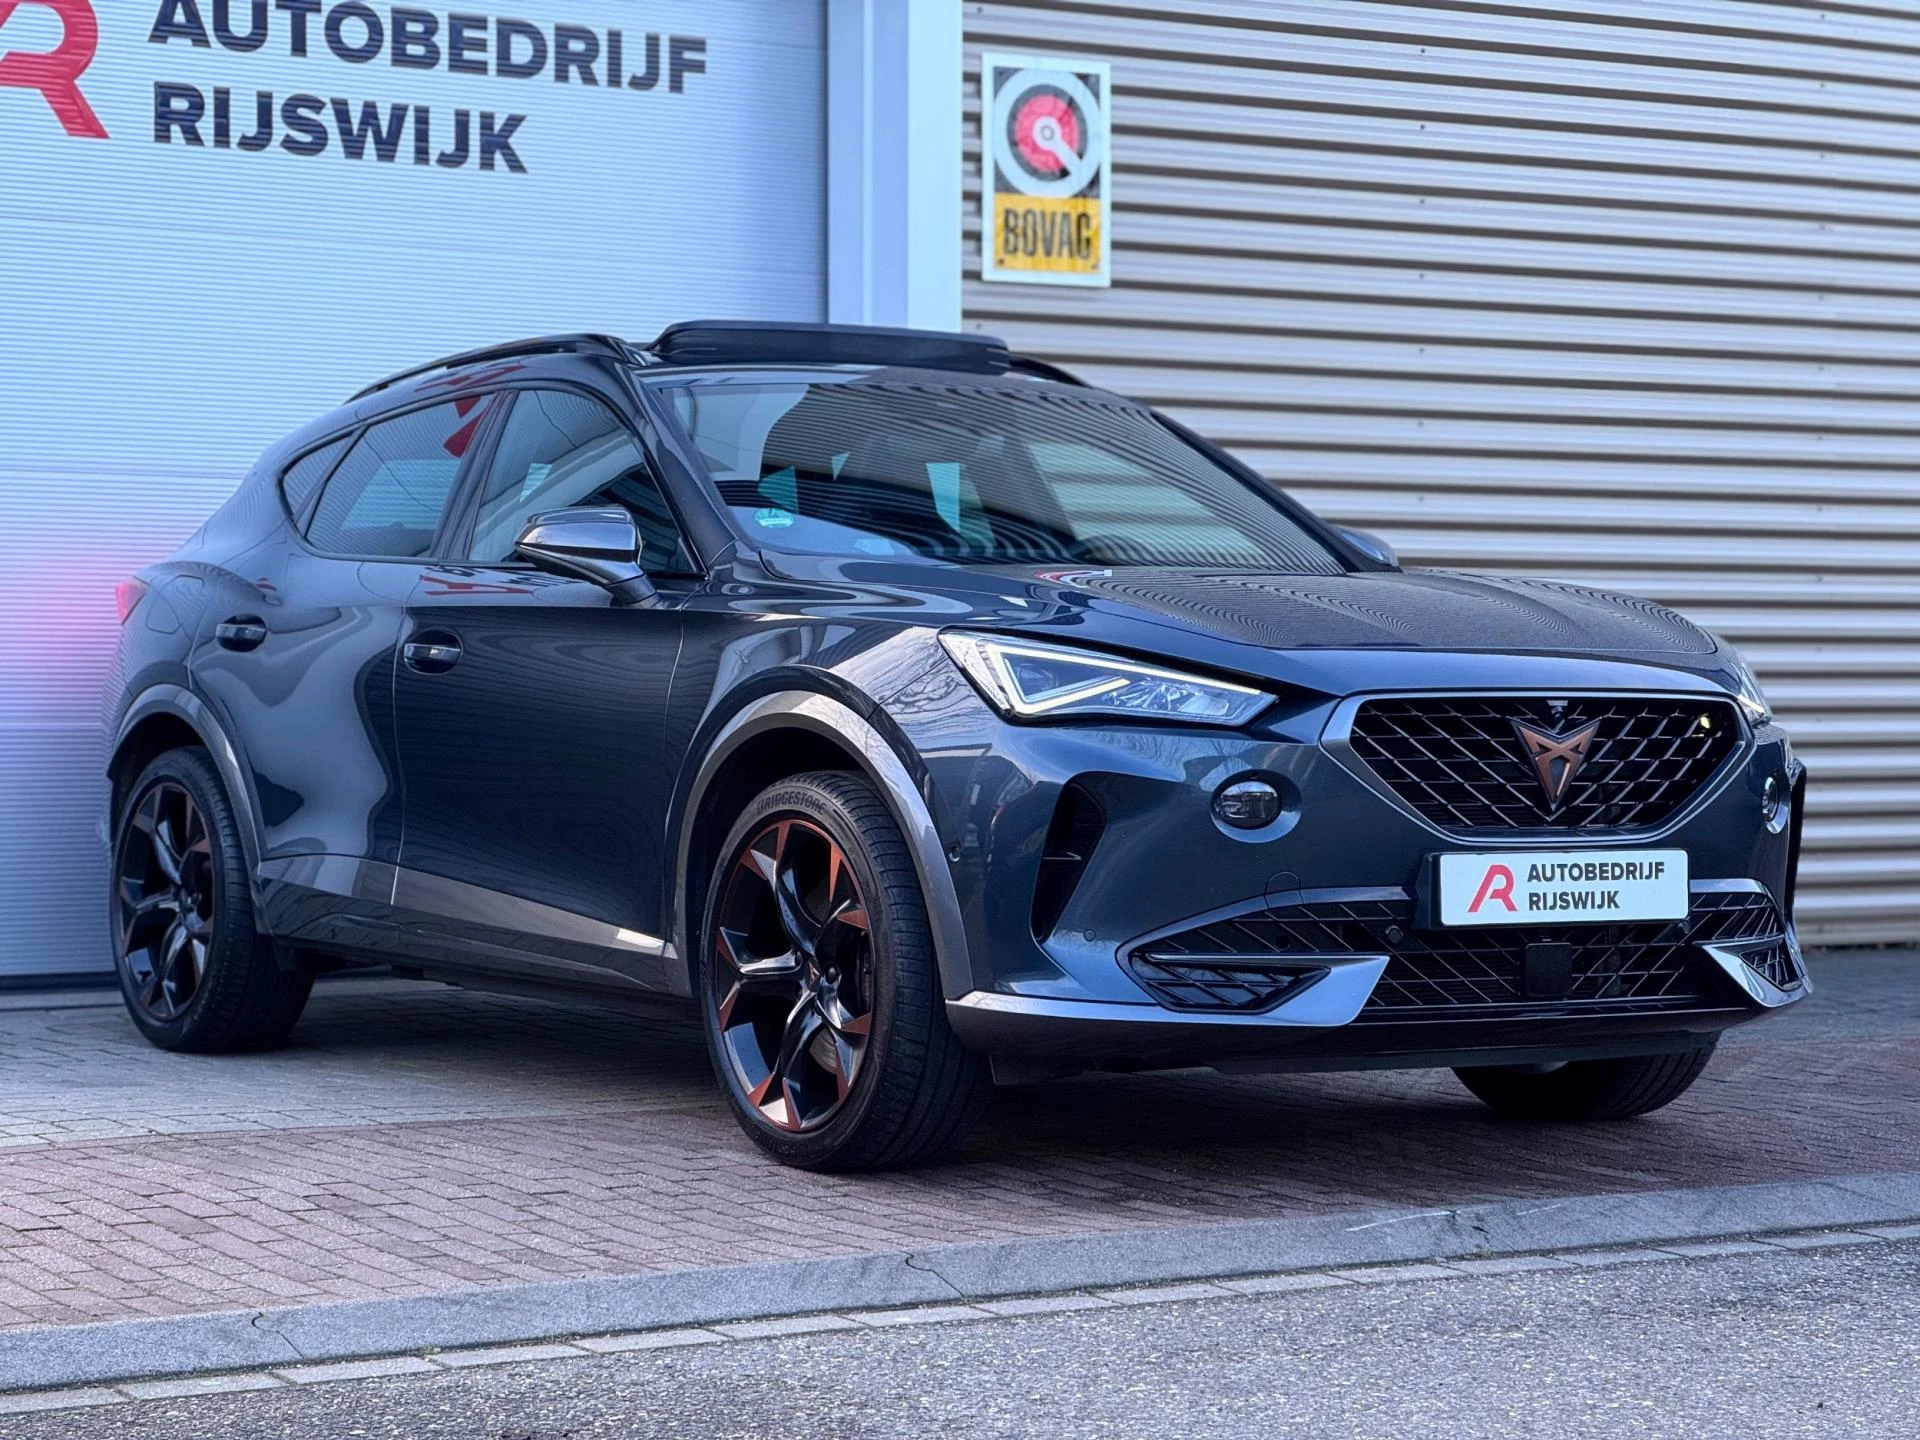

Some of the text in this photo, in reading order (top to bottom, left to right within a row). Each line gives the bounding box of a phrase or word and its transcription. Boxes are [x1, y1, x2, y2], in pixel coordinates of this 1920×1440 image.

[148, 0, 707, 93] AUTOBEDRIJF
[153, 81, 528, 173] RIJSWIJK
[1004, 208, 1091, 259] BOVAG
[1527, 861, 1665, 883] AUTOBEDRIJF
[1529, 890, 1620, 911] RIJSWIJK
